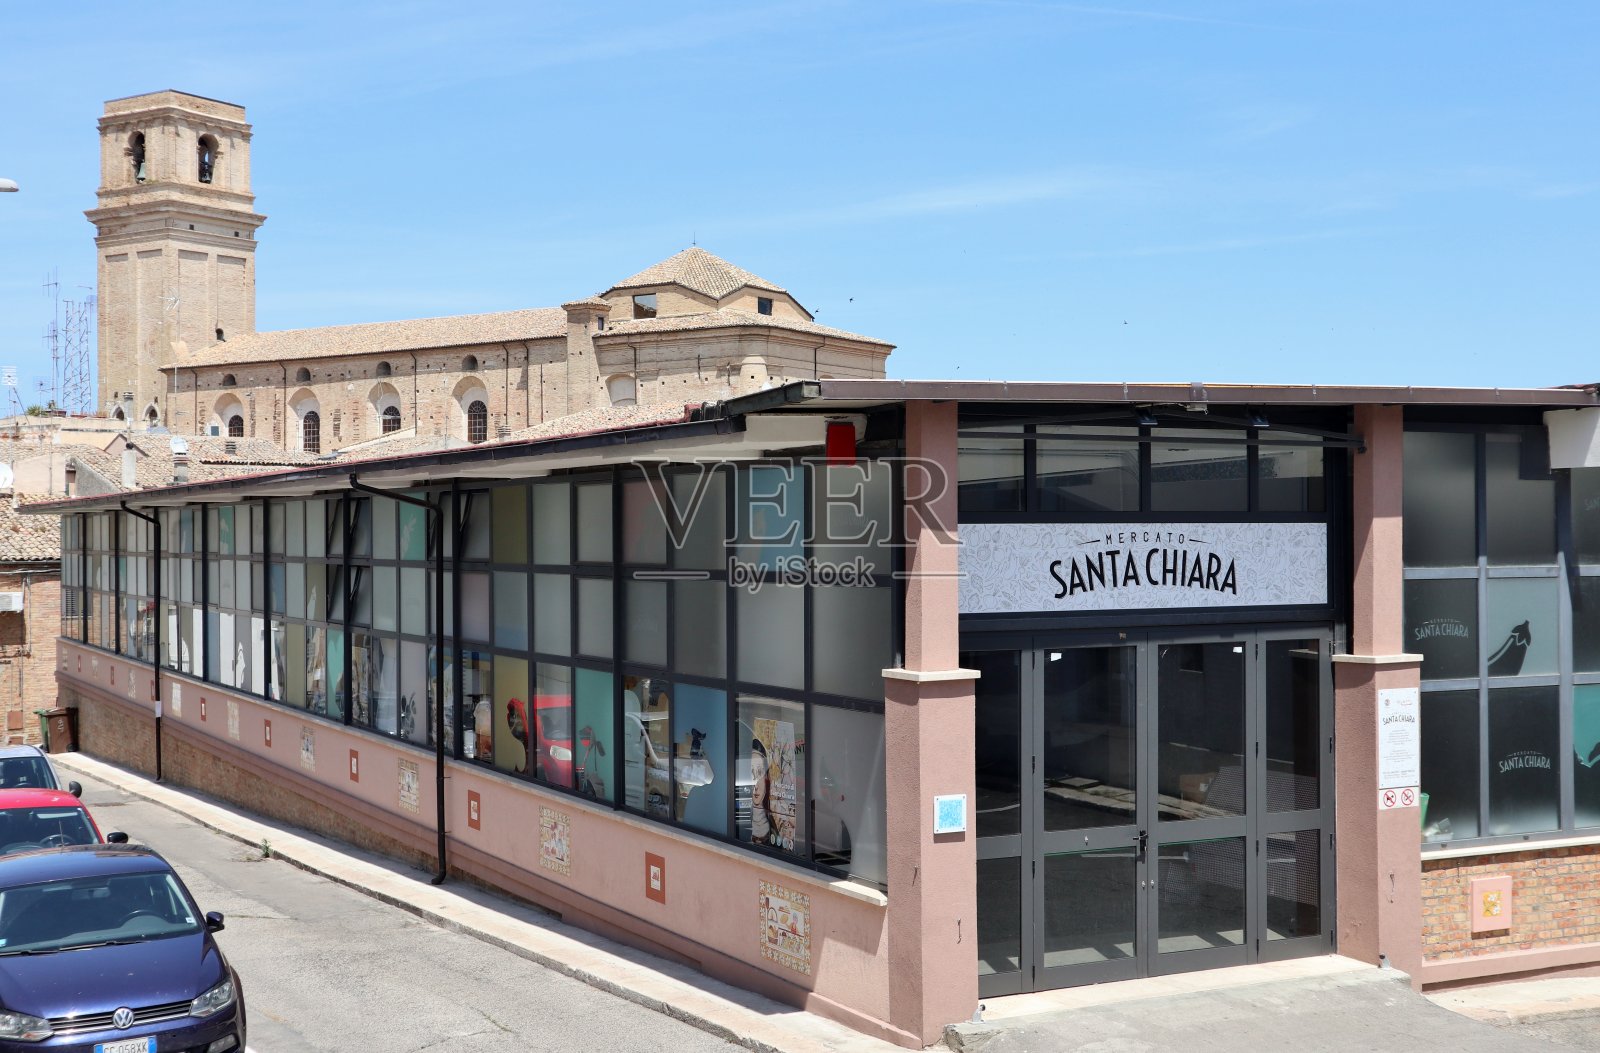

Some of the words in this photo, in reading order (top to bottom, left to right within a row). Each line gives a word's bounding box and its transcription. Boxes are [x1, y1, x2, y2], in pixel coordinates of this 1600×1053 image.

[1105, 531, 1186, 545] MERCATO
[1049, 549, 1140, 599] SANTA
[1145, 548, 1238, 595] CHIARA
[1415, 624, 1440, 640] SANTA
[1441, 623, 1469, 639] CHIARA
[1499, 757, 1523, 773] SANTA
[1524, 755, 1551, 769] CHIARA
